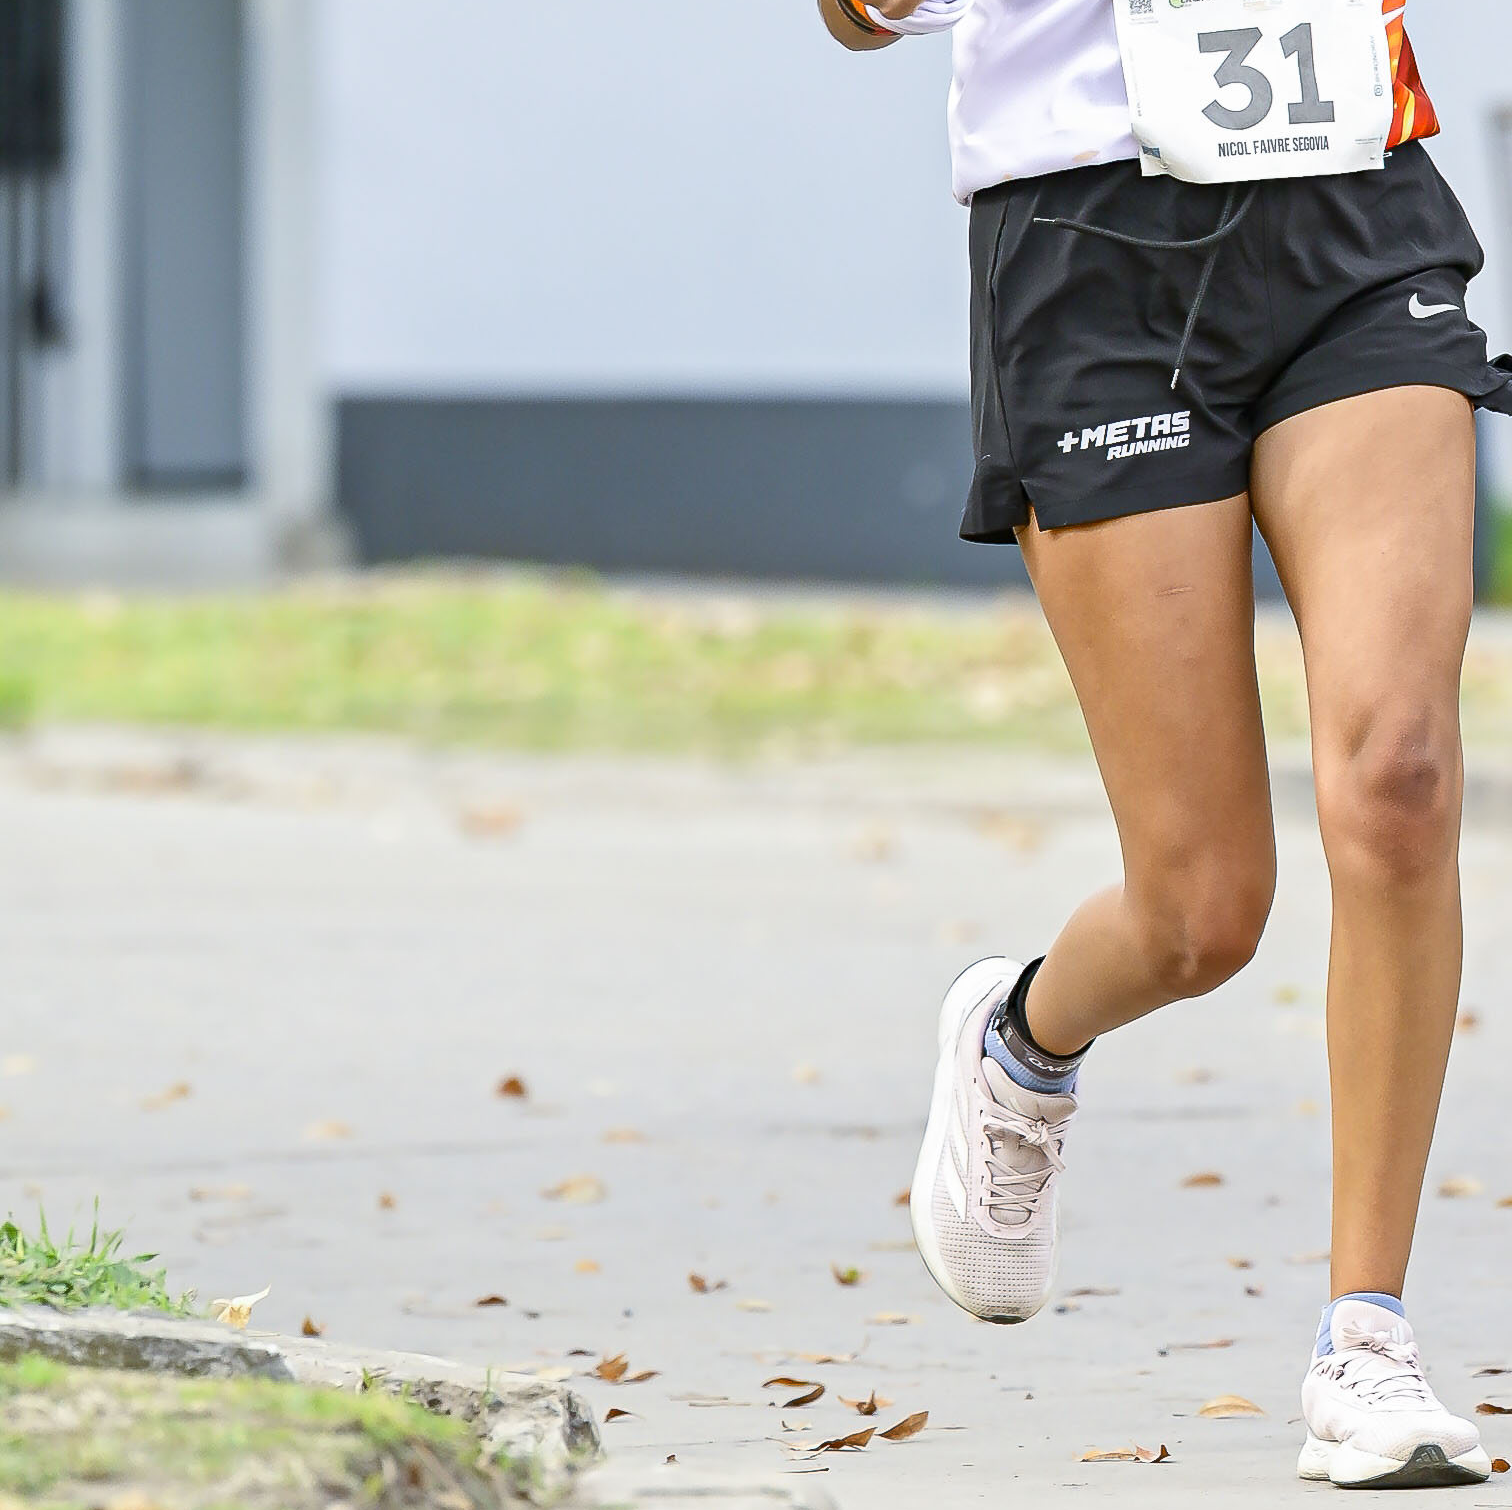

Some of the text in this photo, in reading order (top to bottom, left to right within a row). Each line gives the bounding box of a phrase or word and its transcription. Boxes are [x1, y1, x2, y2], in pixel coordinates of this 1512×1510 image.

[1197, 22, 1335, 131] 31
[1218, 135, 1330, 157] NICOL FAIVRE SEGOVIA
[1106, 433, 1191, 461] RUNNING
